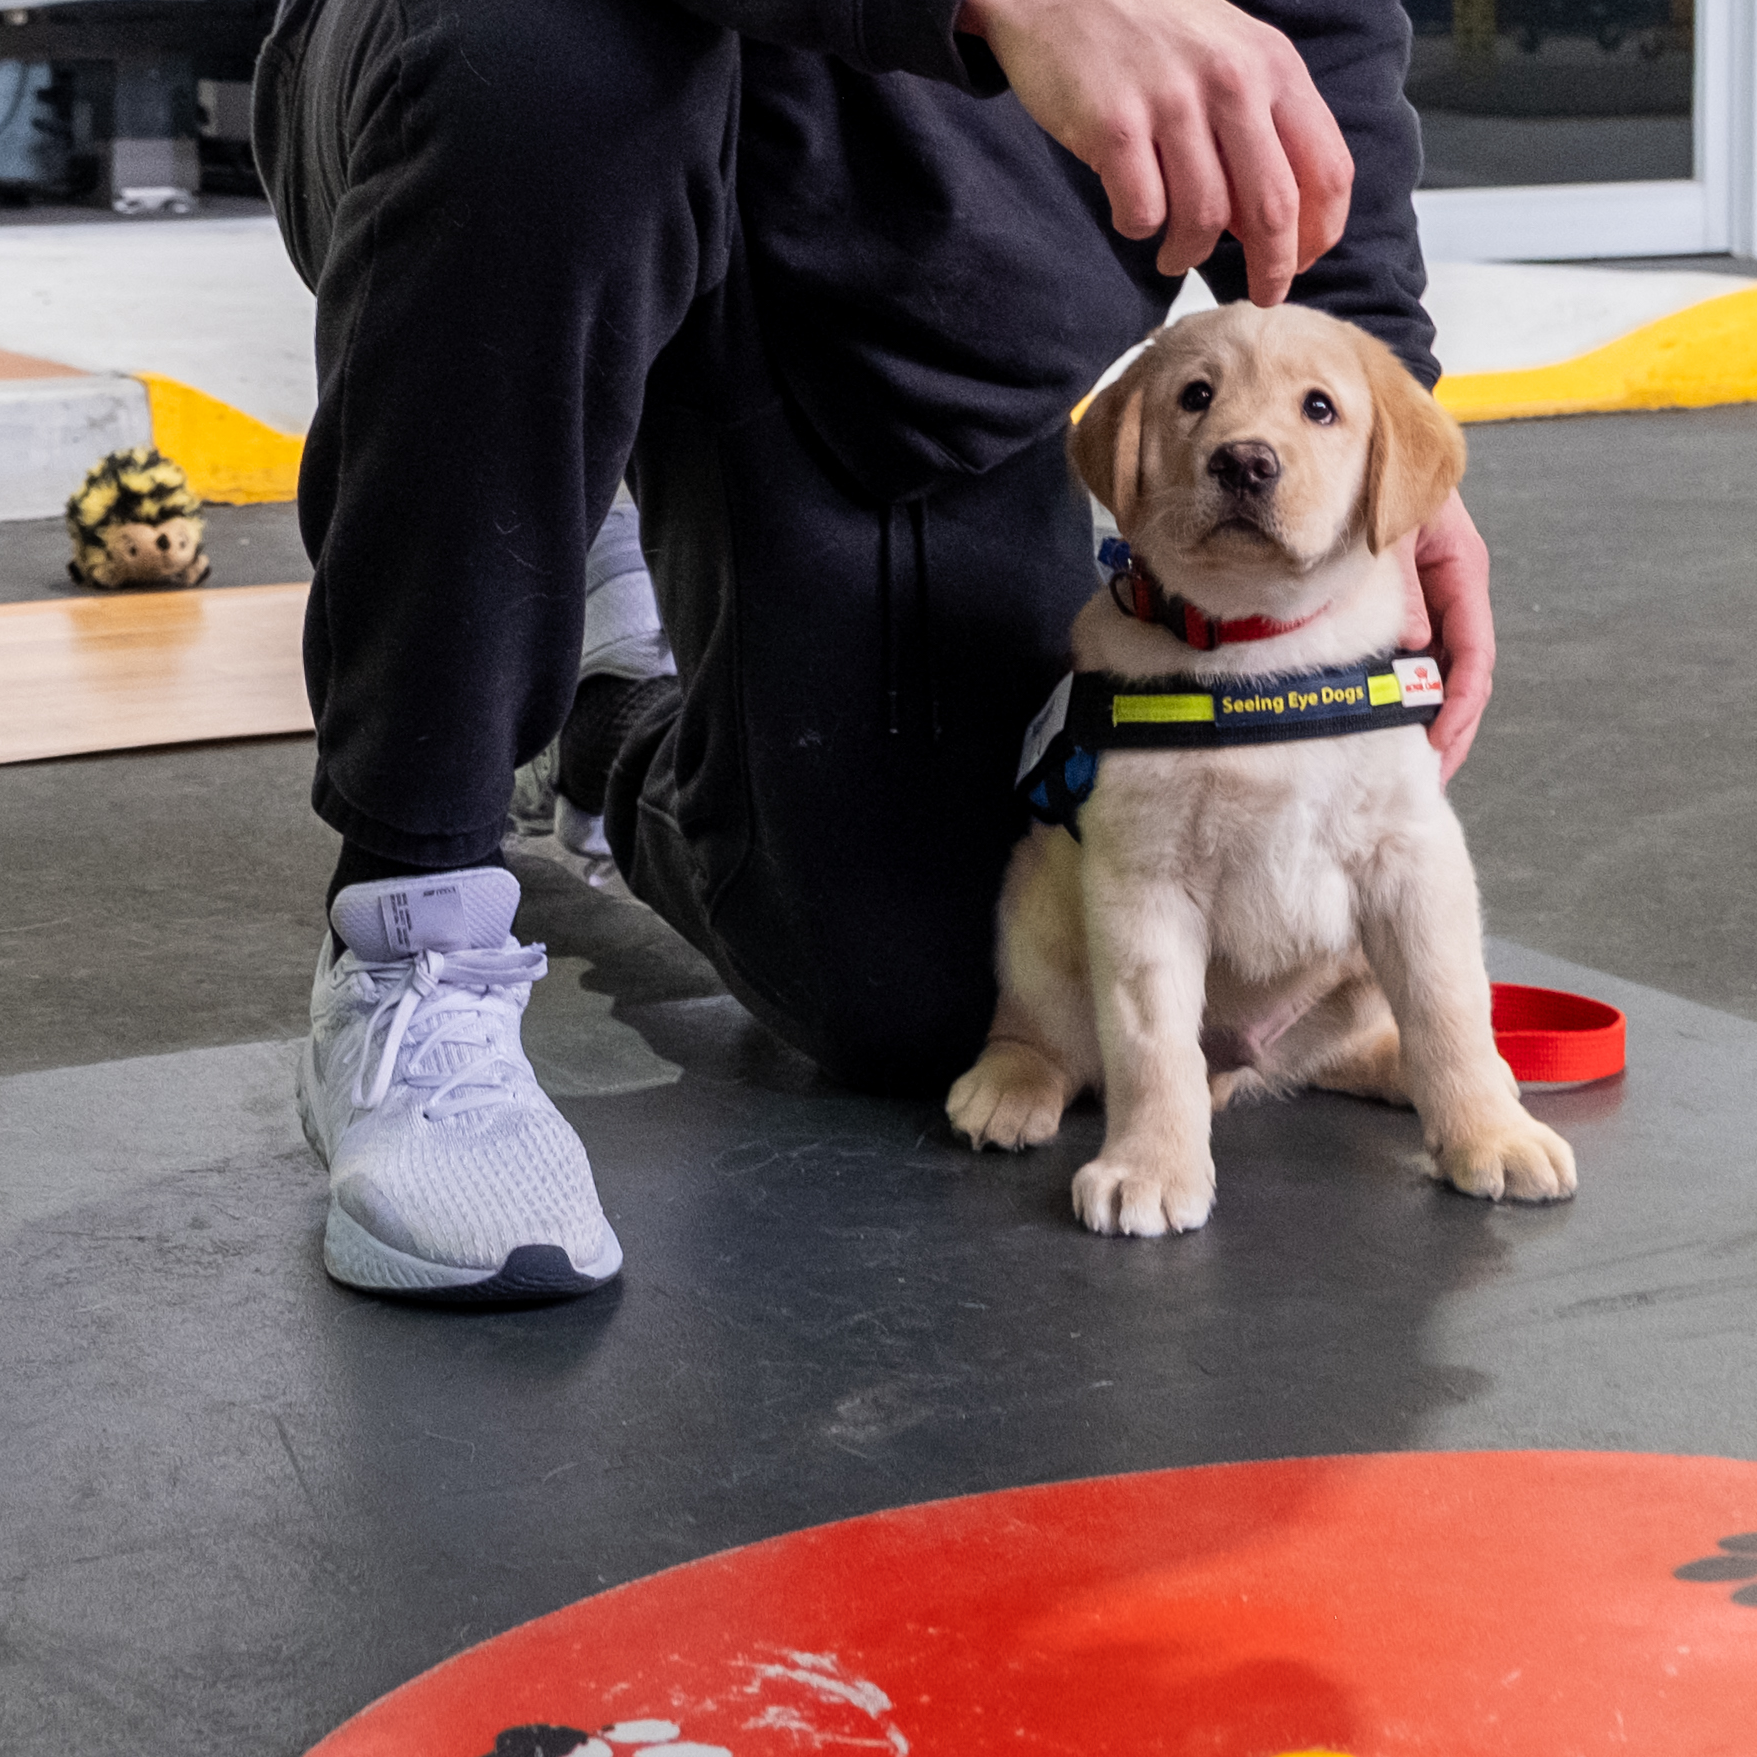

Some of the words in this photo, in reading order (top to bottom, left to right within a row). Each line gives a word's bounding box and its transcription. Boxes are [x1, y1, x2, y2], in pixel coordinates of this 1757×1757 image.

[1222, 694, 1284, 714] Seeing
[1288, 691, 1318, 712] Eye
[1321, 686, 1364, 704] Dogs
